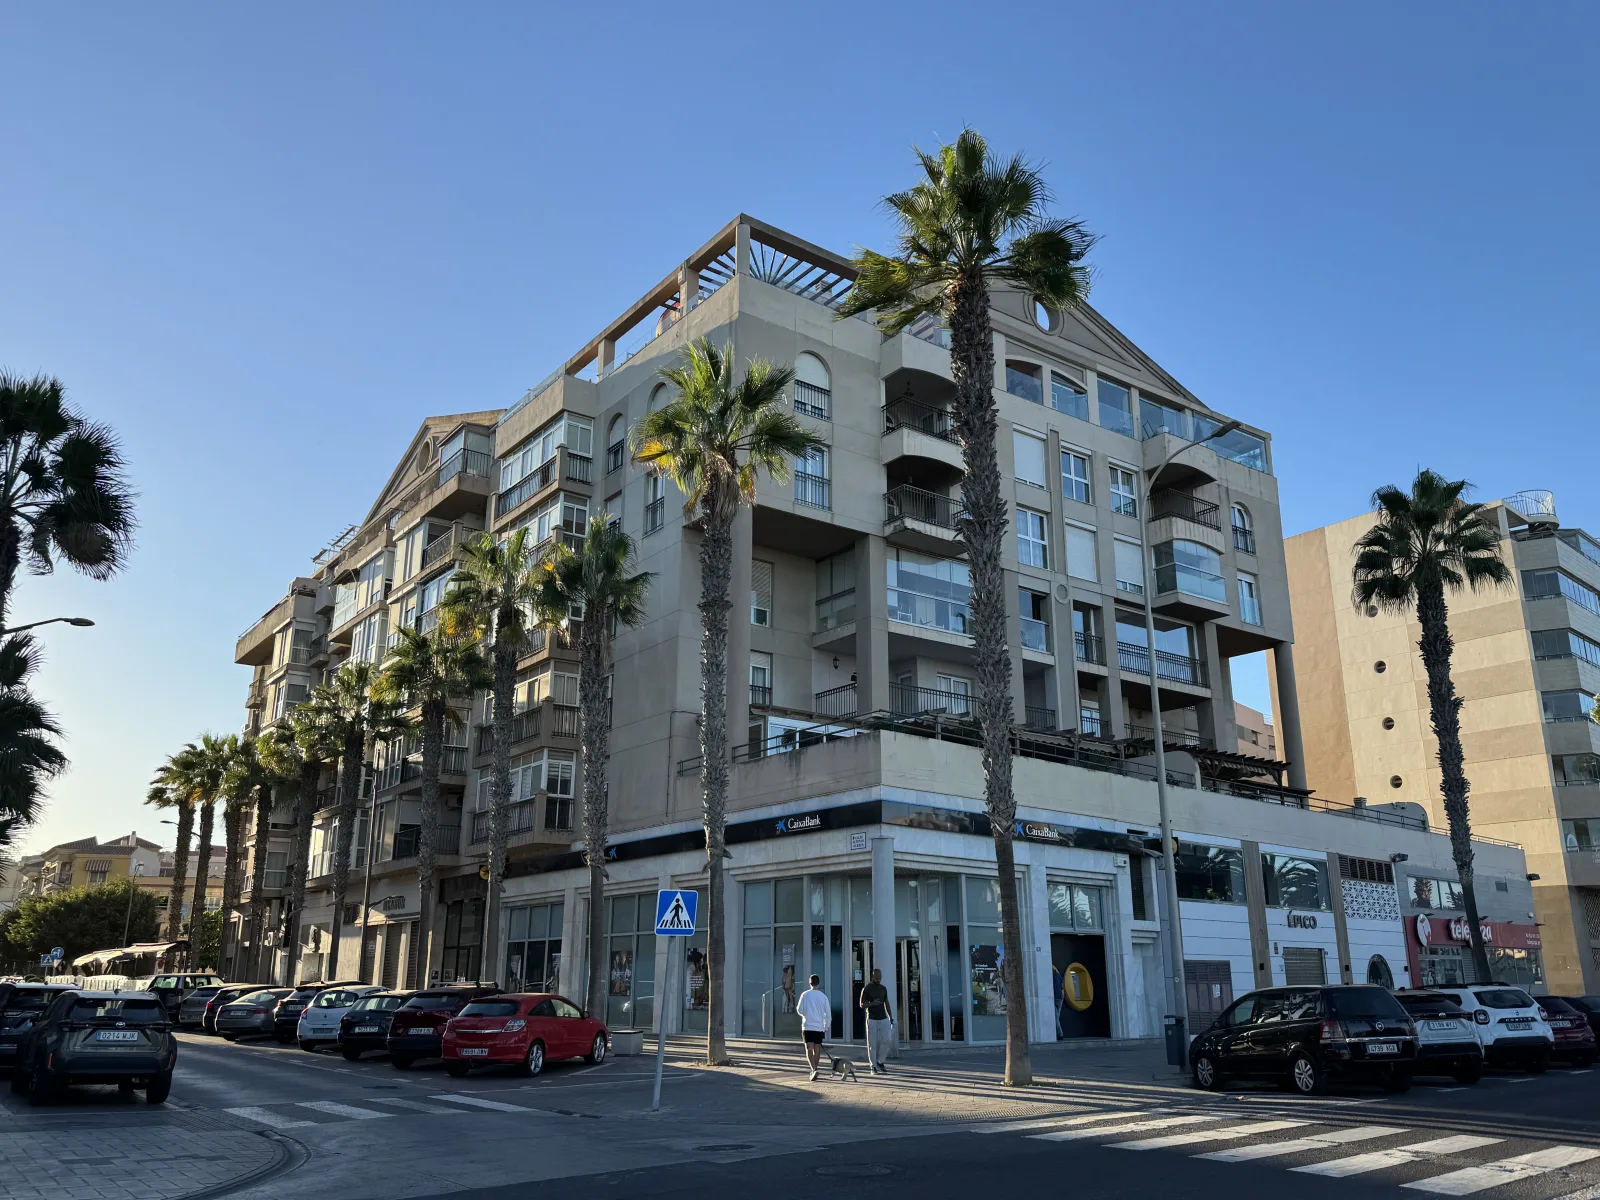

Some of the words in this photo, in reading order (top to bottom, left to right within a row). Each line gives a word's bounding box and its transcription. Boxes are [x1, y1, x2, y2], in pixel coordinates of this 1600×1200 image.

[788, 815, 821, 829] CaixaBank
[1026, 824, 1060, 839] CaixaBank
[1287, 910, 1317, 929] ÉPICO
[102, 1032, 120, 1040] 0214
